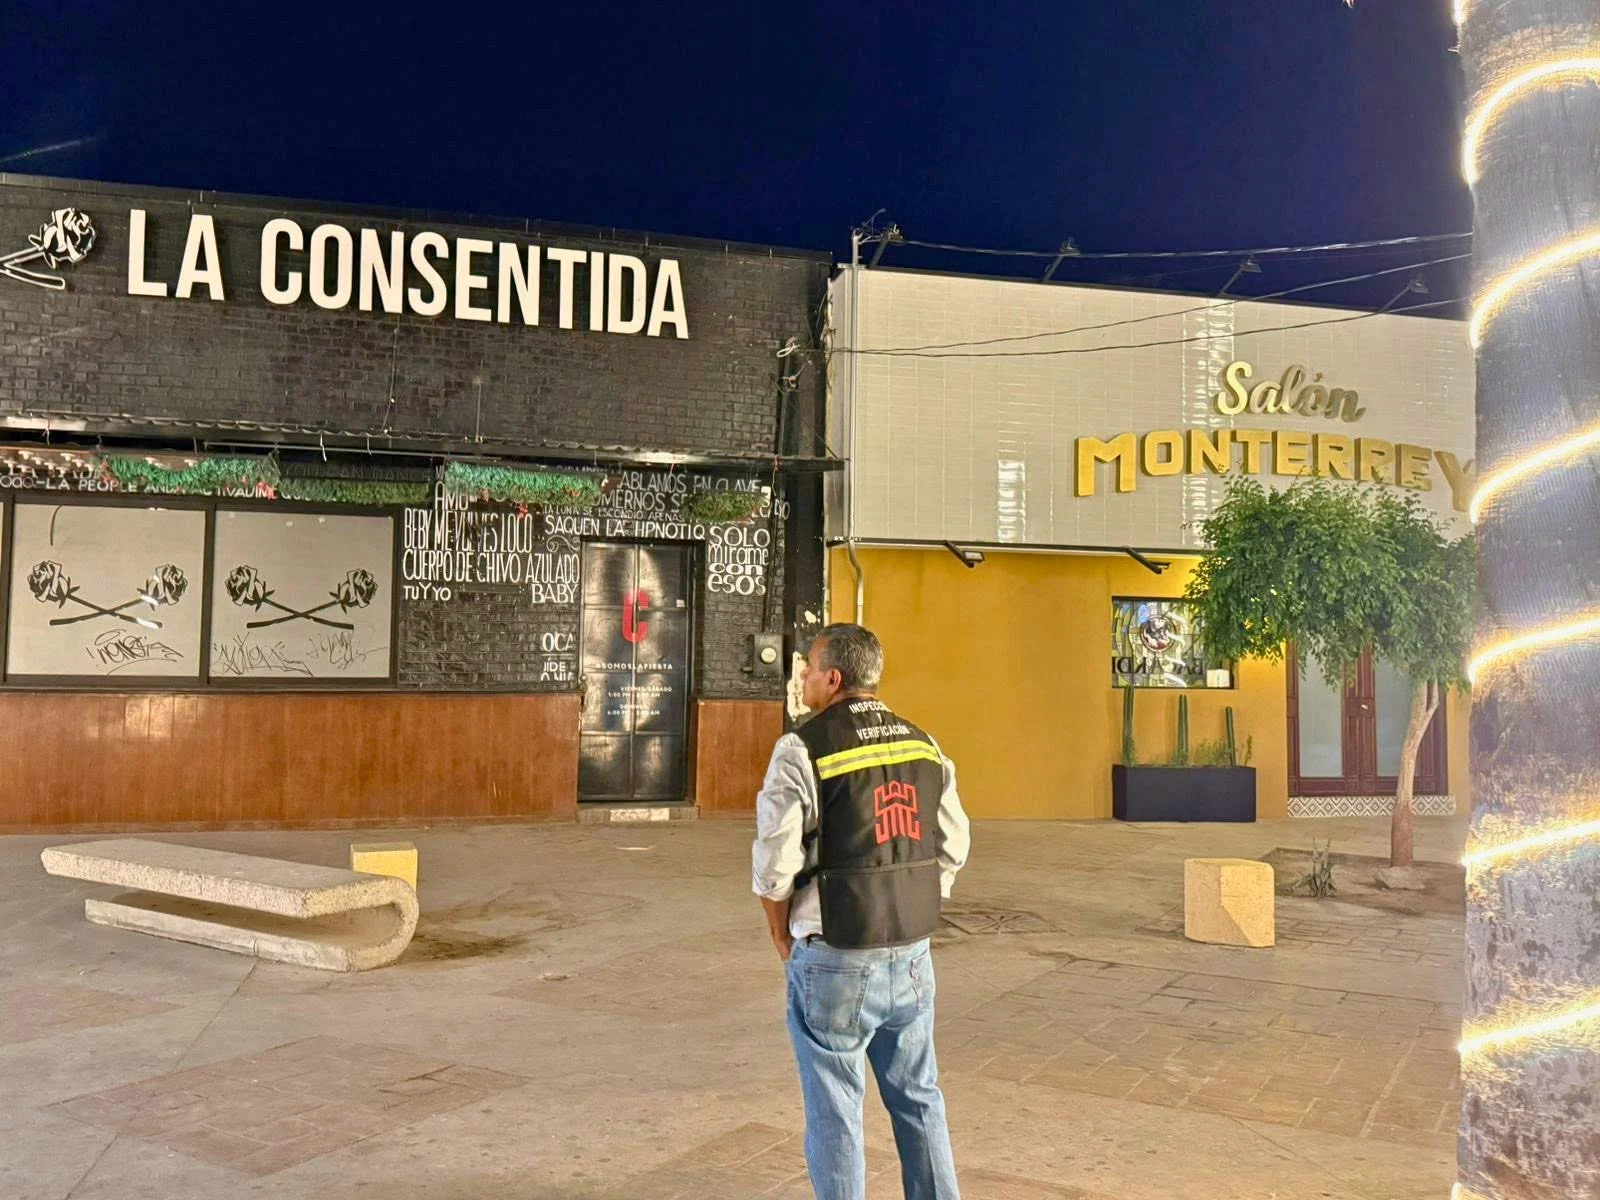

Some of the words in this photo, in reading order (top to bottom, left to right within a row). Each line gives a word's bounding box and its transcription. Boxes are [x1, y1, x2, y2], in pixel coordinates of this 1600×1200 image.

[128, 209, 224, 300] LA
[260, 218, 690, 339] CONSENTIDA
[1216, 361, 1366, 422] Salón
[1074, 430, 1476, 512] MONTERREY
[404, 508, 433, 549] BEBY
[434, 510, 452, 552] ME
[501, 513, 533, 553] LOCO
[545, 515, 599, 536] SAQUEN
[606, 519, 625, 537] LA
[709, 526, 771, 548] SOLO
[402, 549, 453, 582] CUERPO
[456, 552, 473, 582] DE
[477, 552, 521, 583] CHIVO
[525, 553, 580, 584] AZULADO
[709, 562, 763, 575] con
[531, 583, 579, 604] BABY
[708, 573, 766, 596] esos
